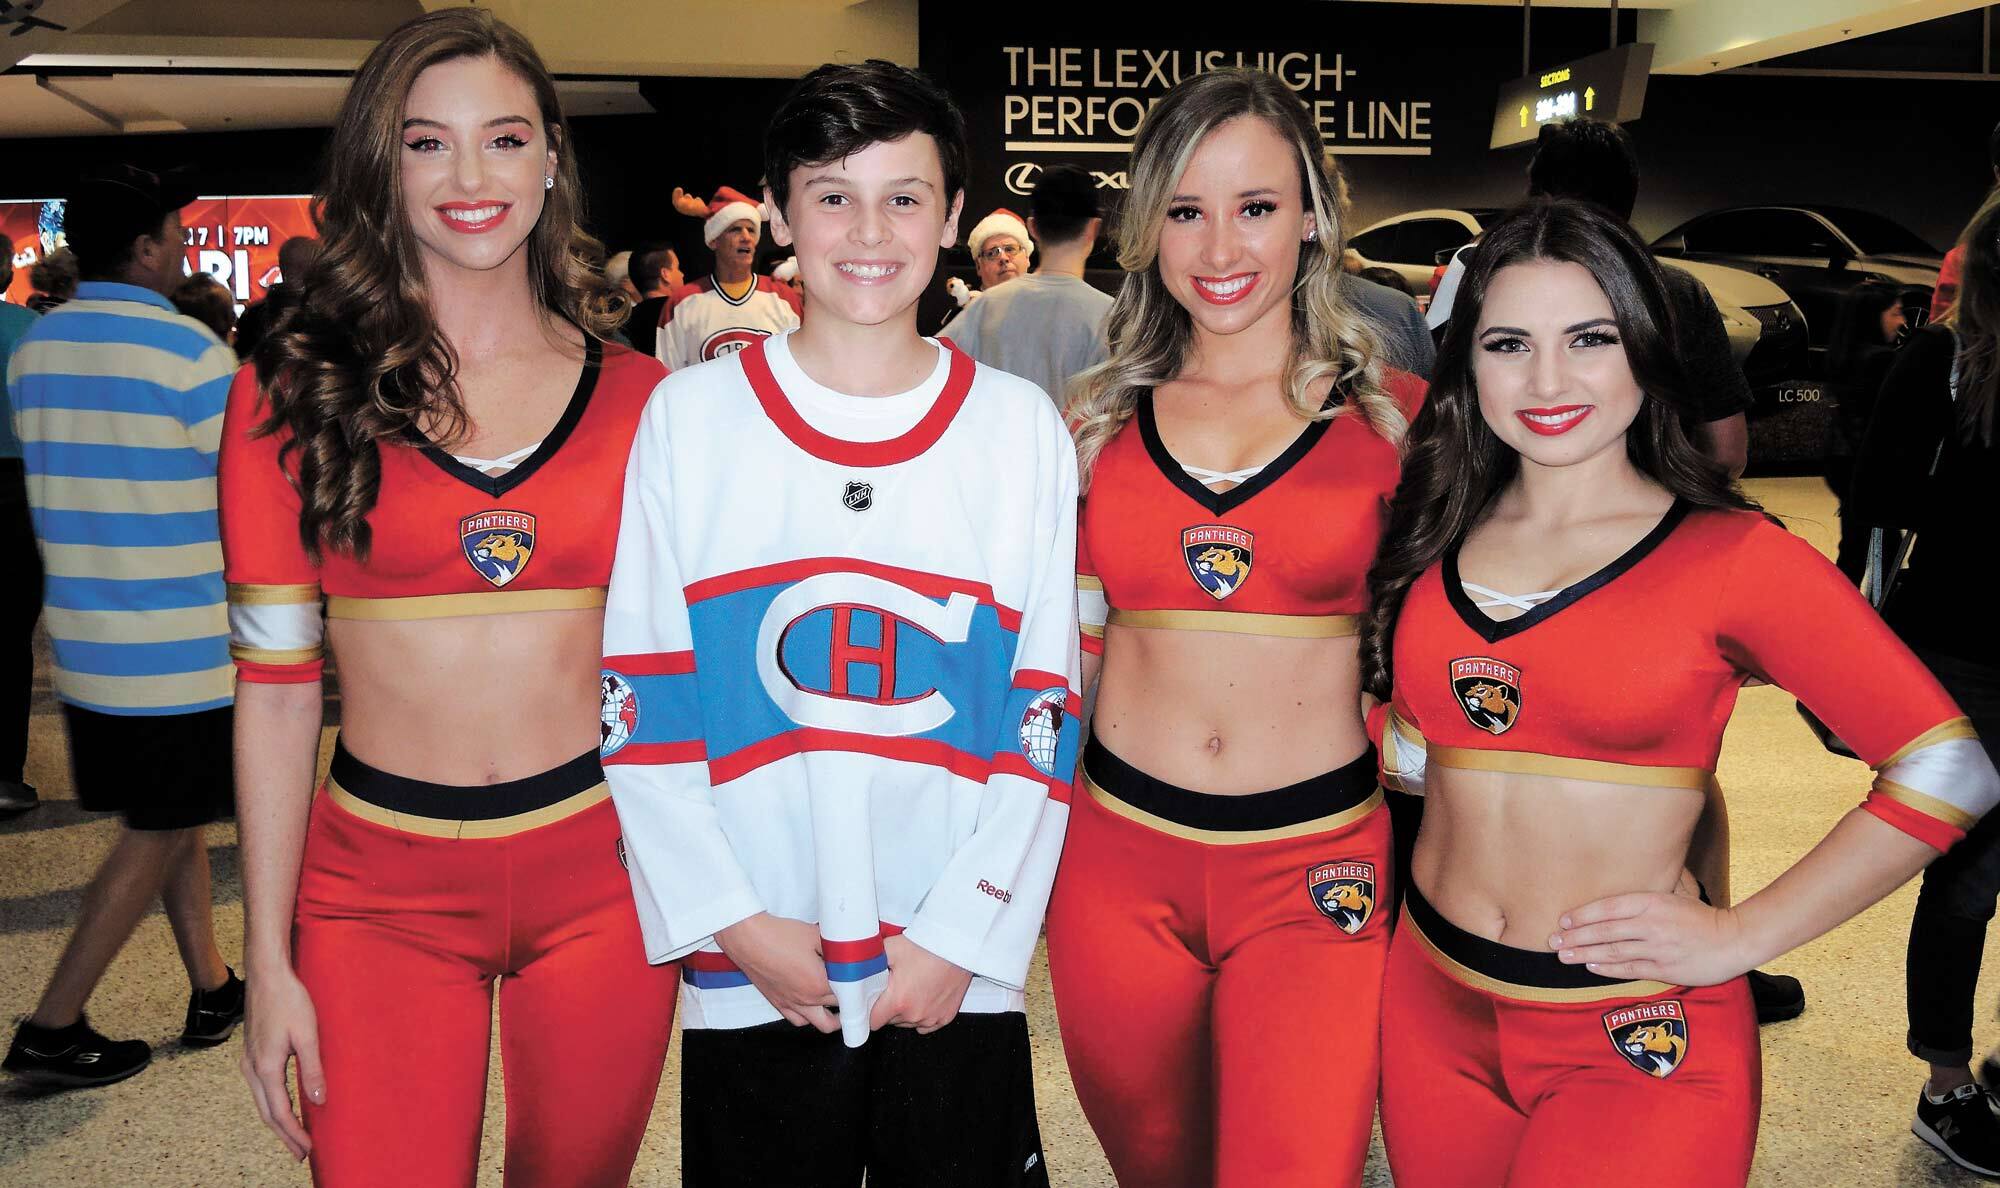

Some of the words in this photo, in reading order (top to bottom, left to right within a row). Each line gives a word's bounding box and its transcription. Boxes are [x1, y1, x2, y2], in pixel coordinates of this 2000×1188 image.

[1003, 46, 1083, 87] THE
[1540, 67, 1571, 88] SECTIONS
[1004, 95, 1336, 139] PERFOE
[1347, 101, 1432, 140] LINE
[233, 226, 269, 245] 7PM
[1779, 389, 1794, 402] LC
[1796, 389, 1820, 402] 500
[467, 515, 529, 532] PANTHERS
[1189, 529, 1248, 546] PANTHERS
[1457, 662, 1514, 683] PANTHERS
[1314, 866, 1369, 882] PANTHERS
[1611, 1003, 1676, 1027] PANTHERS
